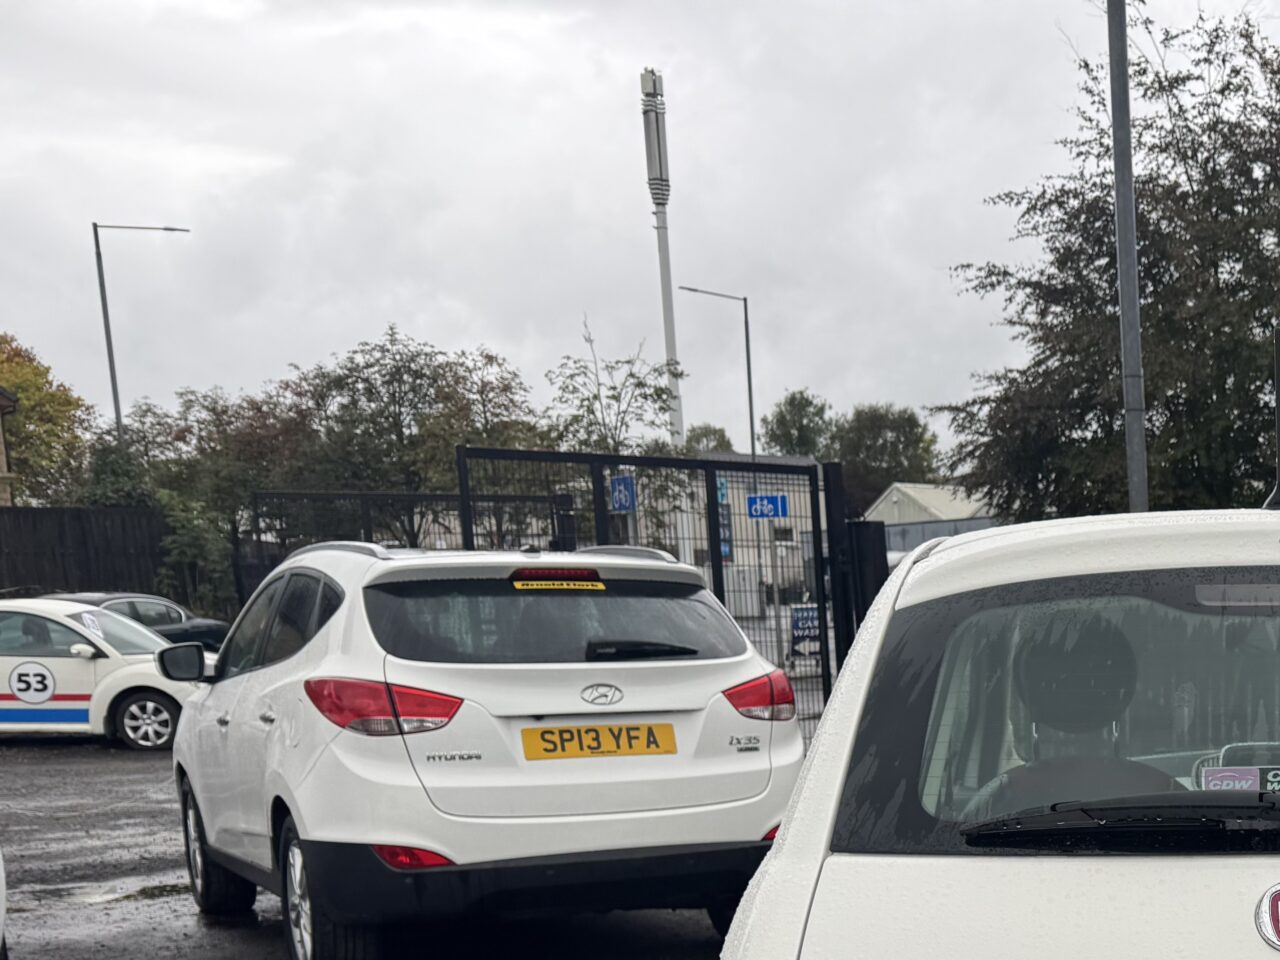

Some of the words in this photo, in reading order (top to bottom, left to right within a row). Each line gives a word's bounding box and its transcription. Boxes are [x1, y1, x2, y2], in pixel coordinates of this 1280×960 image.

[16, 672, 49, 693] 53
[540, 728, 602, 753] SP13
[608, 726, 660, 750] YFA
[426, 751, 482, 762] HYUNDAI
[1208, 780, 1252, 790] CDW
